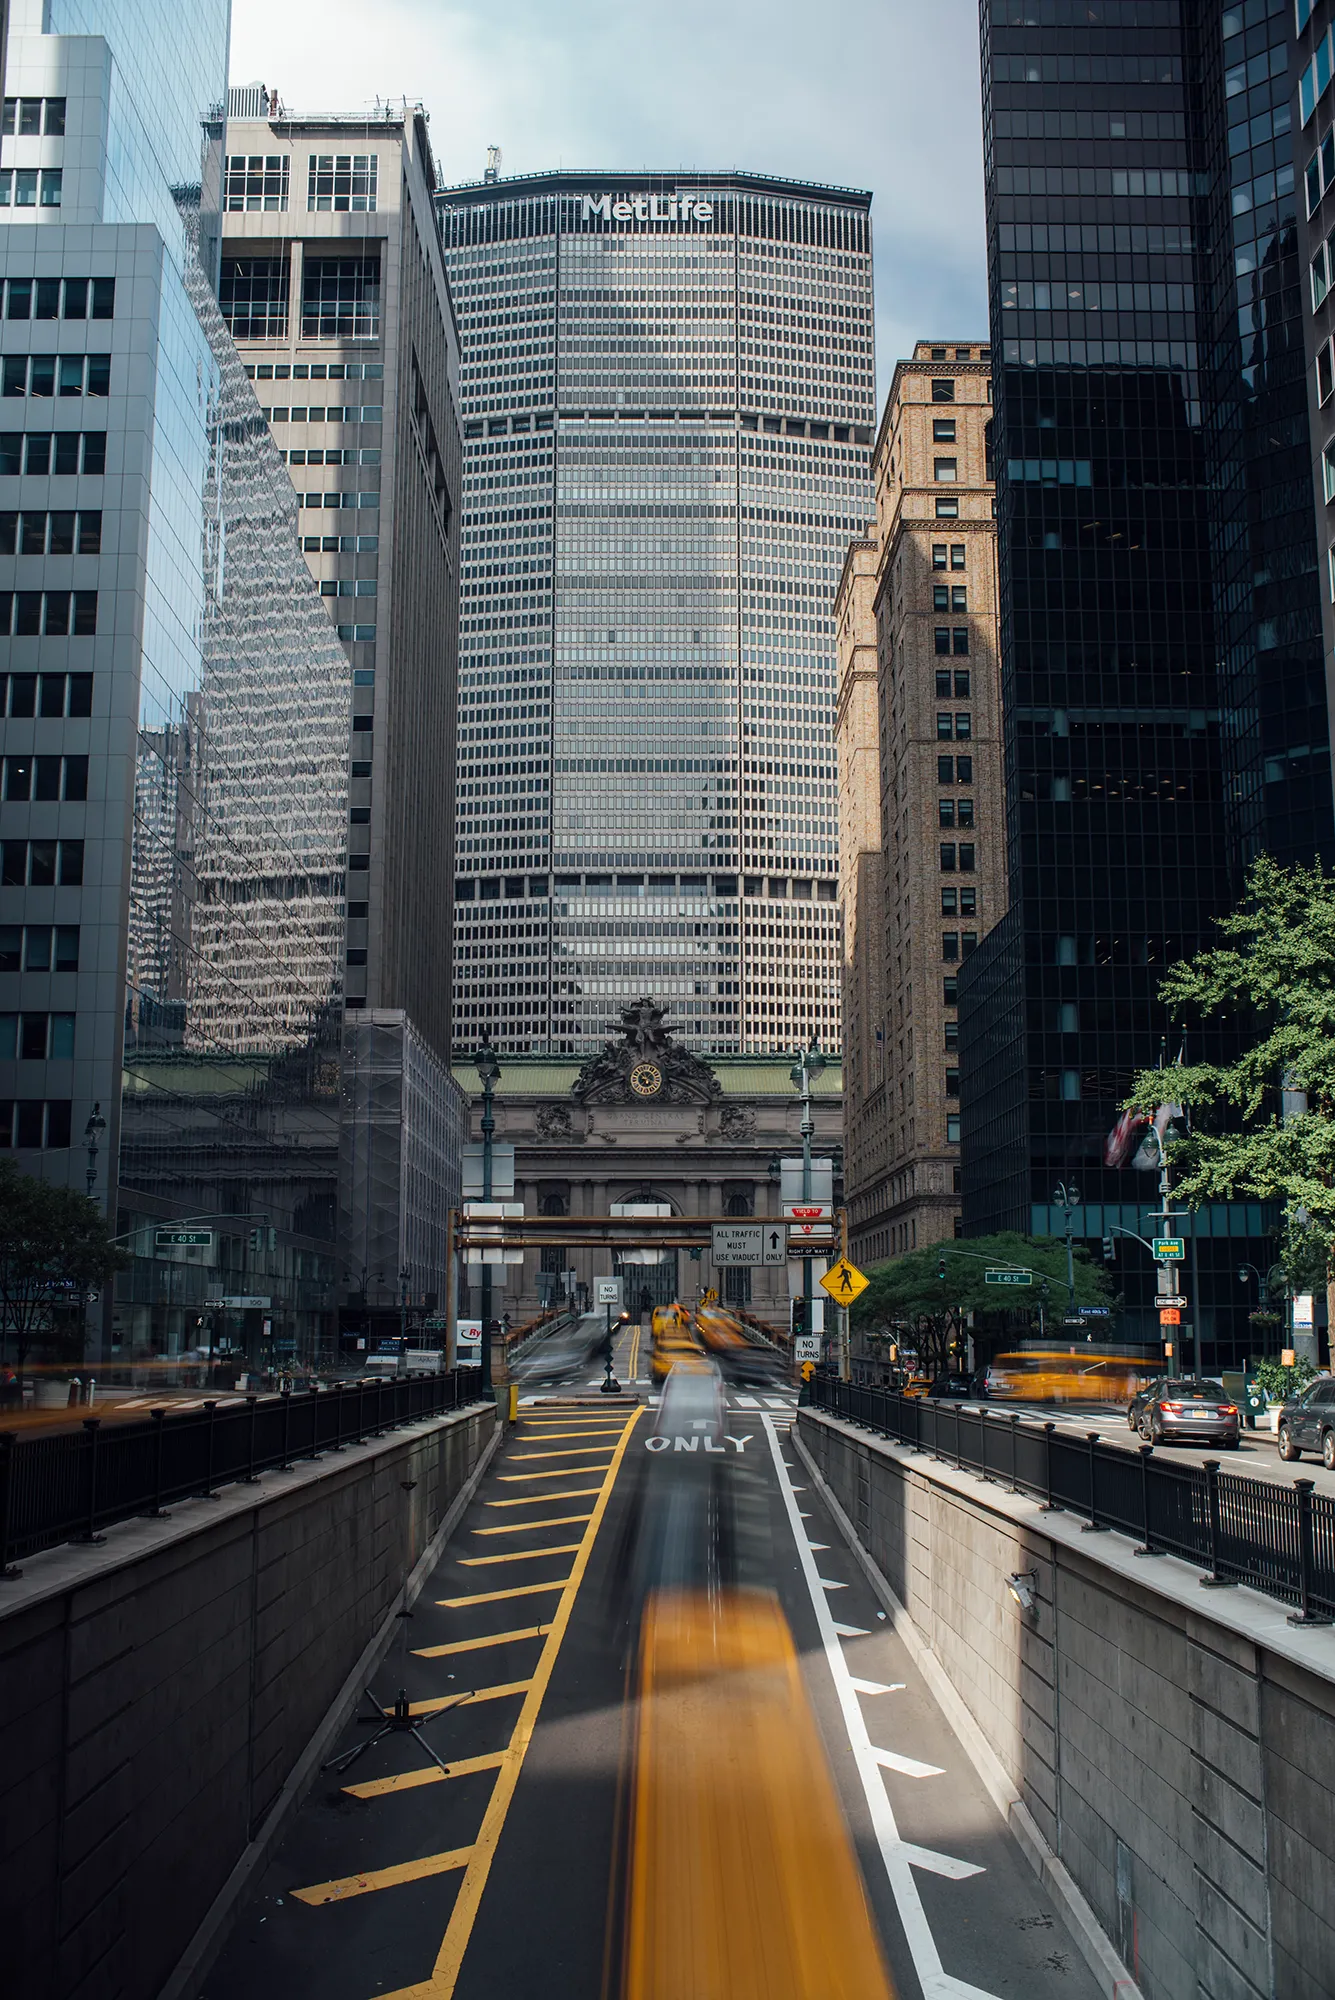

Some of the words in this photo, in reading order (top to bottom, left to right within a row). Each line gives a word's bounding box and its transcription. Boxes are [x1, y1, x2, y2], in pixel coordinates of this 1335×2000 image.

[582, 195, 713, 221] MetLife
[644, 1112, 684, 1120] CENTRAL
[469, 1329, 482, 1337] Ry
[644, 1435, 754, 1452] ONLY
